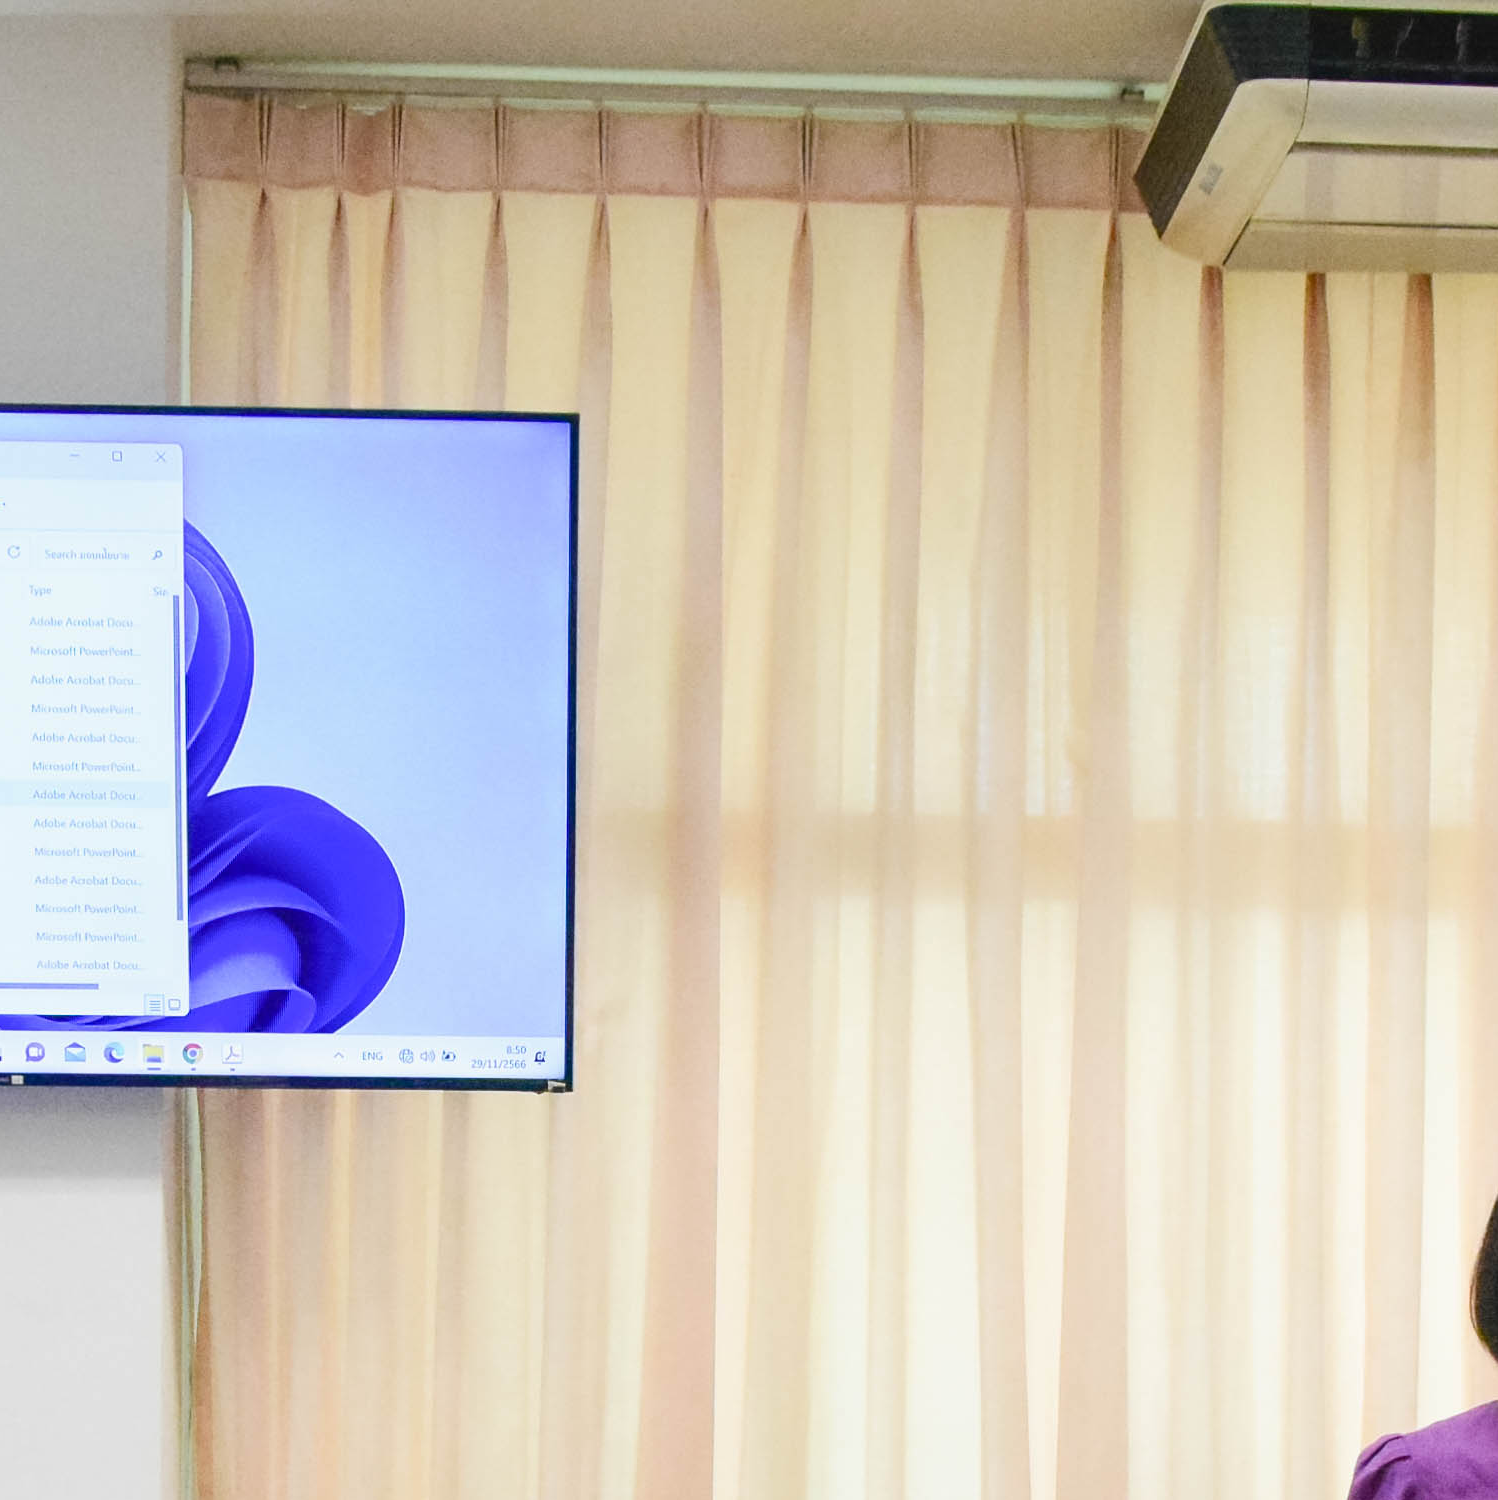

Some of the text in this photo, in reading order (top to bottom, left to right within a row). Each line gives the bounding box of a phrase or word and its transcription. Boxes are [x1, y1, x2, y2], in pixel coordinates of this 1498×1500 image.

[44, 547, 77, 560] Search
[29, 585, 53, 598] Type
[30, 617, 104, 628] Adobe Acrobat
[30, 645, 76, 656] Microsoft
[31, 675, 105, 686] Adobe Acrobat
[31, 703, 77, 715] Microsoft
[32, 732, 106, 744] Adobe Acrobat
[32, 761, 79, 772] Microsoft
[33, 789, 107, 800] Adobe Acrobat
[33, 818, 107, 829] Adobe Acrobat
[34, 847, 80, 858] Microsoft
[34, 875, 108, 887] Adobe Acrobat
[35, 903, 81, 914] Microsoft
[36, 931, 82, 943] Microsoft
[37, 960, 69, 971] Adobe
[72, 960, 109, 971] Acrobat
[362, 1051, 383, 1061] ENG
[471, 1059, 527, 1070] 29/11/2566
